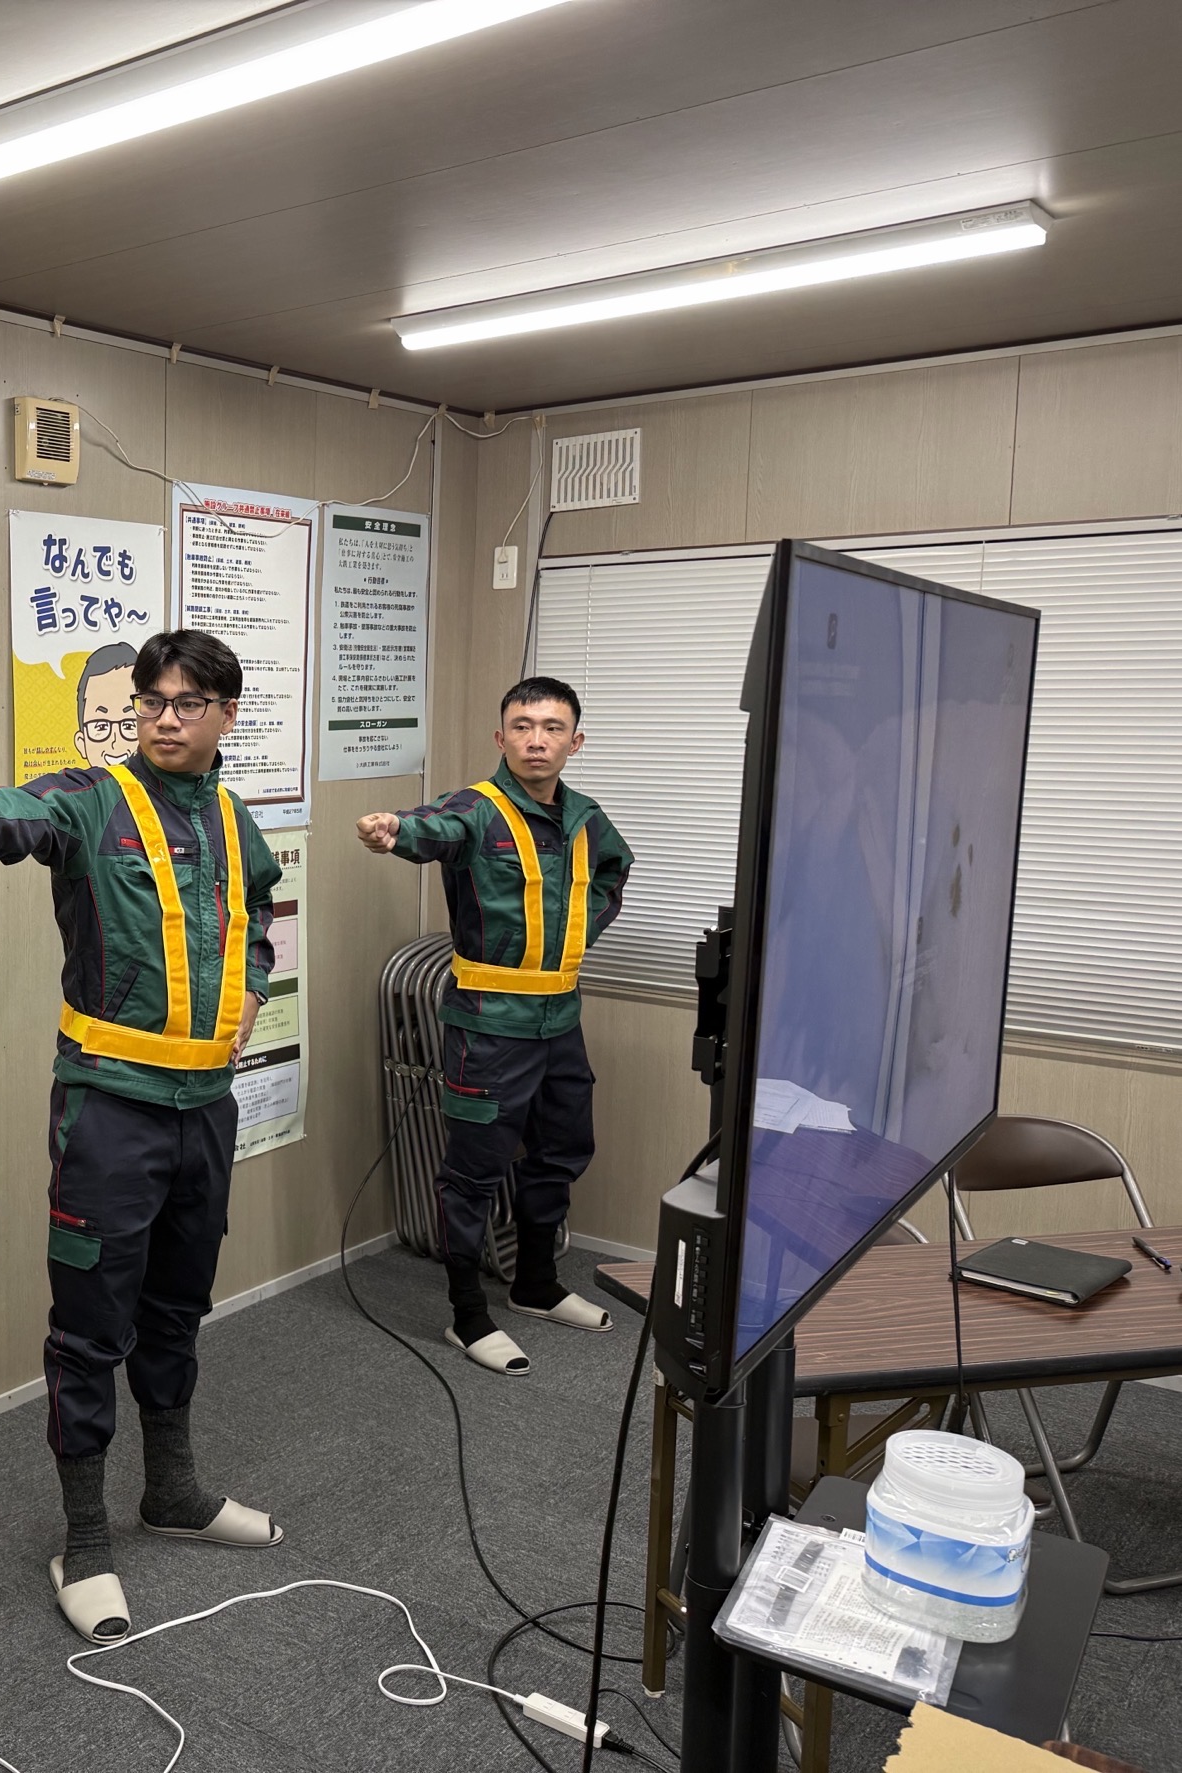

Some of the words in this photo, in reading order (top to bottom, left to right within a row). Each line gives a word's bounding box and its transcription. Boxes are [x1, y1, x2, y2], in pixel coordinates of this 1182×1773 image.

[364, 520, 397, 533] 安全理念
[42, 533, 135, 582] なんでも
[29, 586, 148, 632] 言ってや～
[359, 720, 388, 729] スローガン
